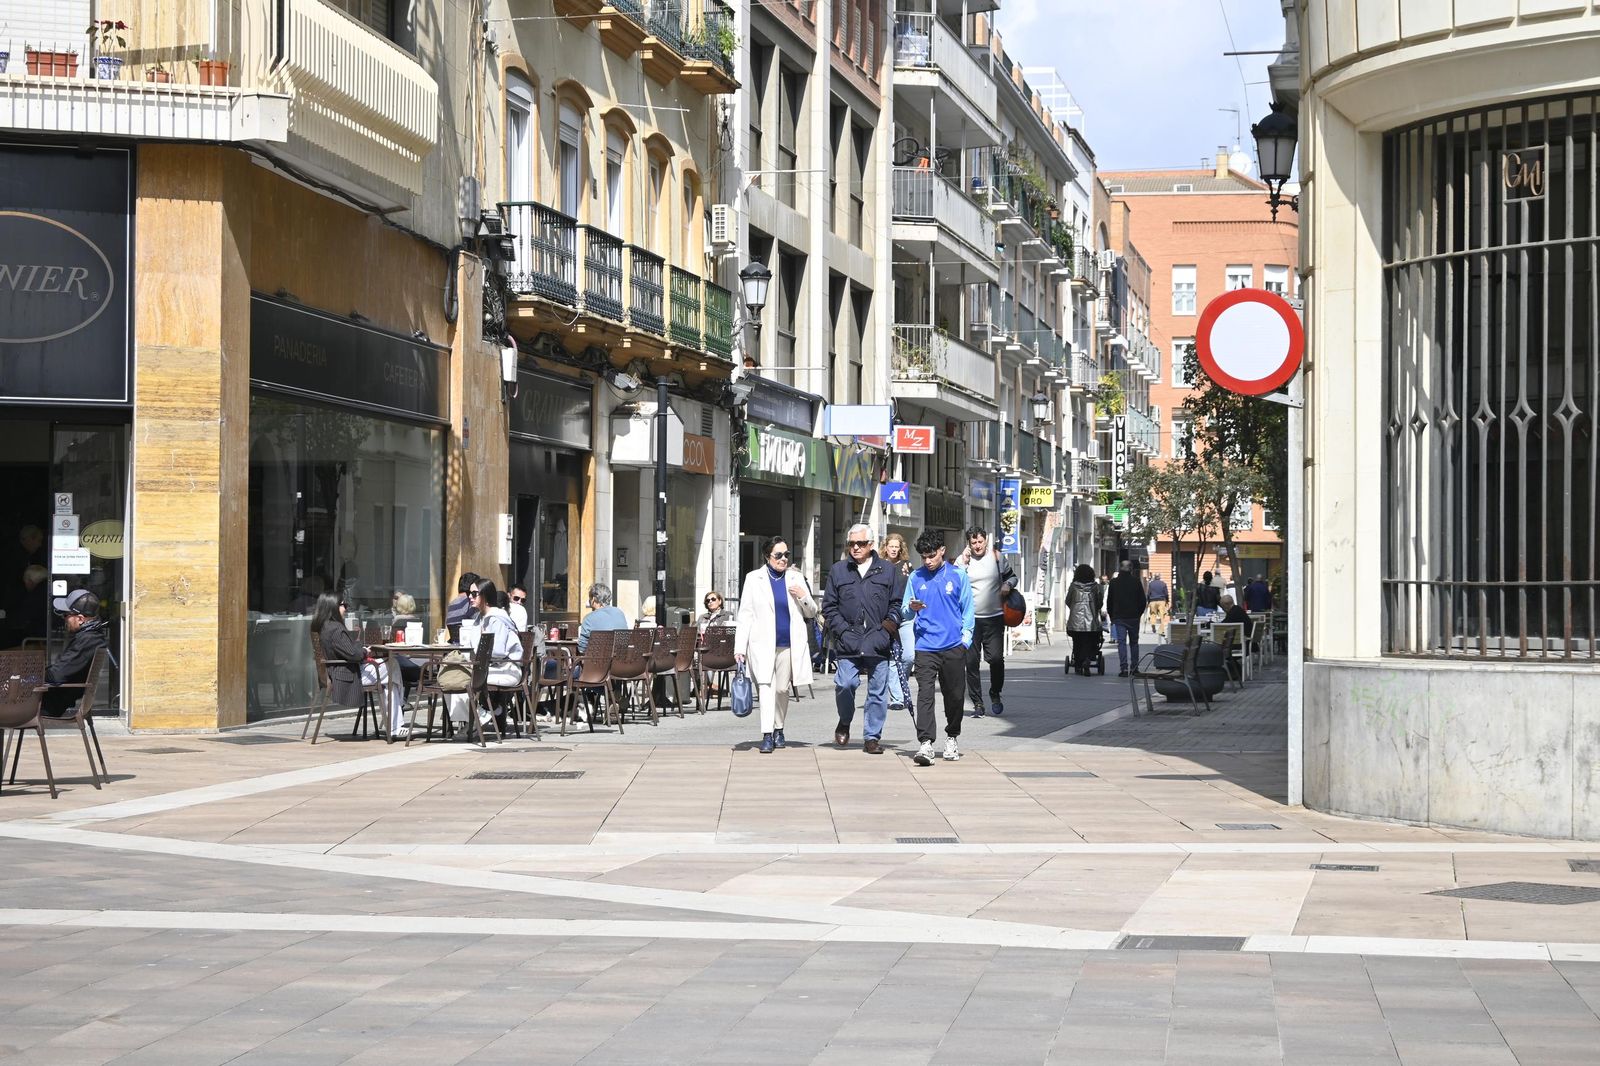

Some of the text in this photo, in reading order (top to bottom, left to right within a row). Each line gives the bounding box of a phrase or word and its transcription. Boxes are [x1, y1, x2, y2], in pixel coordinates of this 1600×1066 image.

[272, 334, 328, 367] PANADERIA
[384, 360, 427, 393] CAFETERA
[888, 490, 906, 500] AXA
[1024, 497, 1042, 505] ORO
